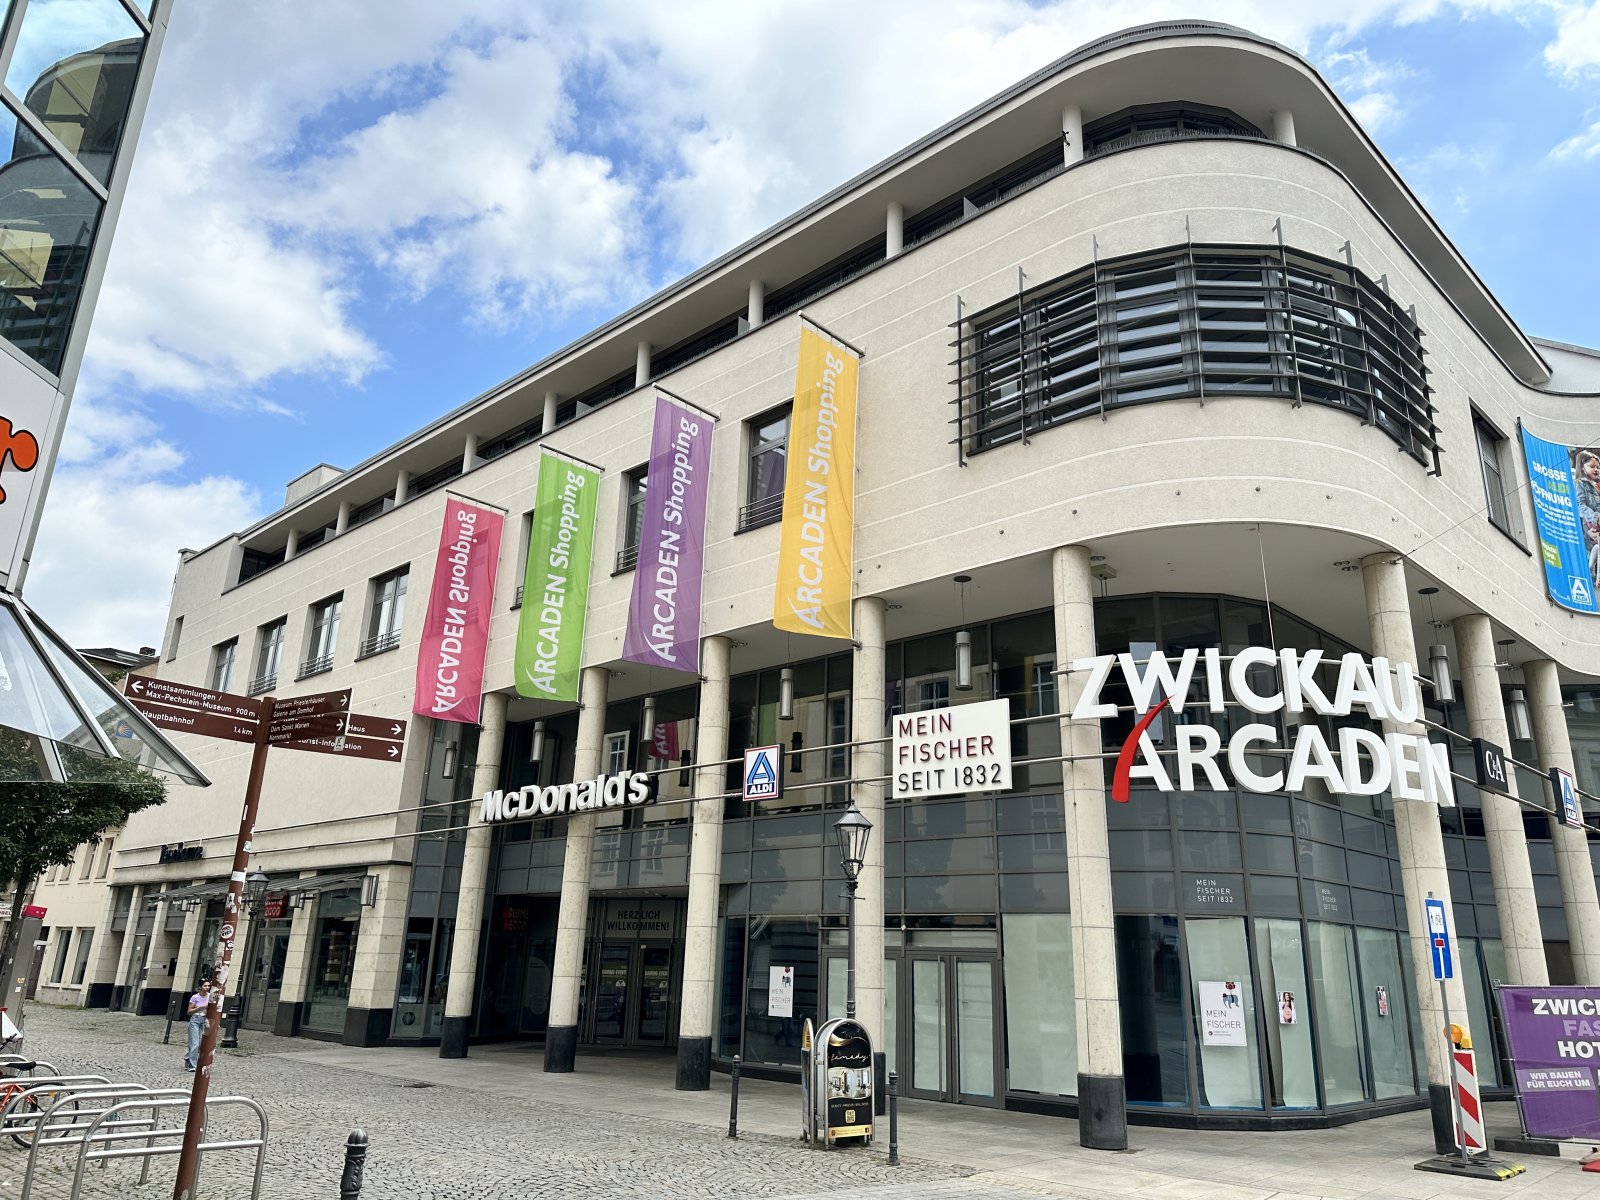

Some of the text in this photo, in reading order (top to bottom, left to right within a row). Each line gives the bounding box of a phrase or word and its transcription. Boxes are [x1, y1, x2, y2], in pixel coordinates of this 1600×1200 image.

[1532, 460, 1568, 482] GROSSE
[787, 351, 844, 629] ARCADEN Shopping
[643, 416, 698, 662] ARCADEN Shopping
[526, 470, 585, 694] ARCADEN Shopping
[147, 680, 216, 701] Kunstsammlungen
[1070, 645, 1420, 724] ZWICKAU
[145, 689, 232, 713] Max-Pechstein-Museum
[235, 707, 249, 716] 900
[142, 709, 195, 726] Hauptbahnhof
[348, 724, 366, 733] Haus
[898, 712, 952, 738] MEIN
[241, 727, 253, 736] km
[898, 735, 995, 765] FISCHER
[1111, 695, 1456, 808] ARCADEN
[898, 762, 1002, 792] SEIT 1832
[1485, 750, 1506, 783] C&A
[478, 769, 649, 823] McDonald's
[748, 782, 775, 797] ALDI
[1196, 887, 1231, 895] FISCHER
[607, 921, 670, 931] WILLKOMMEN!
[1206, 1010, 1227, 1018] MEIN
[1206, 1020, 1242, 1029] FISCHER
[1526, 1079, 1591, 1089] FÜR EUCH UM
[1529, 1070, 1582, 1080] WIR BAUEN
